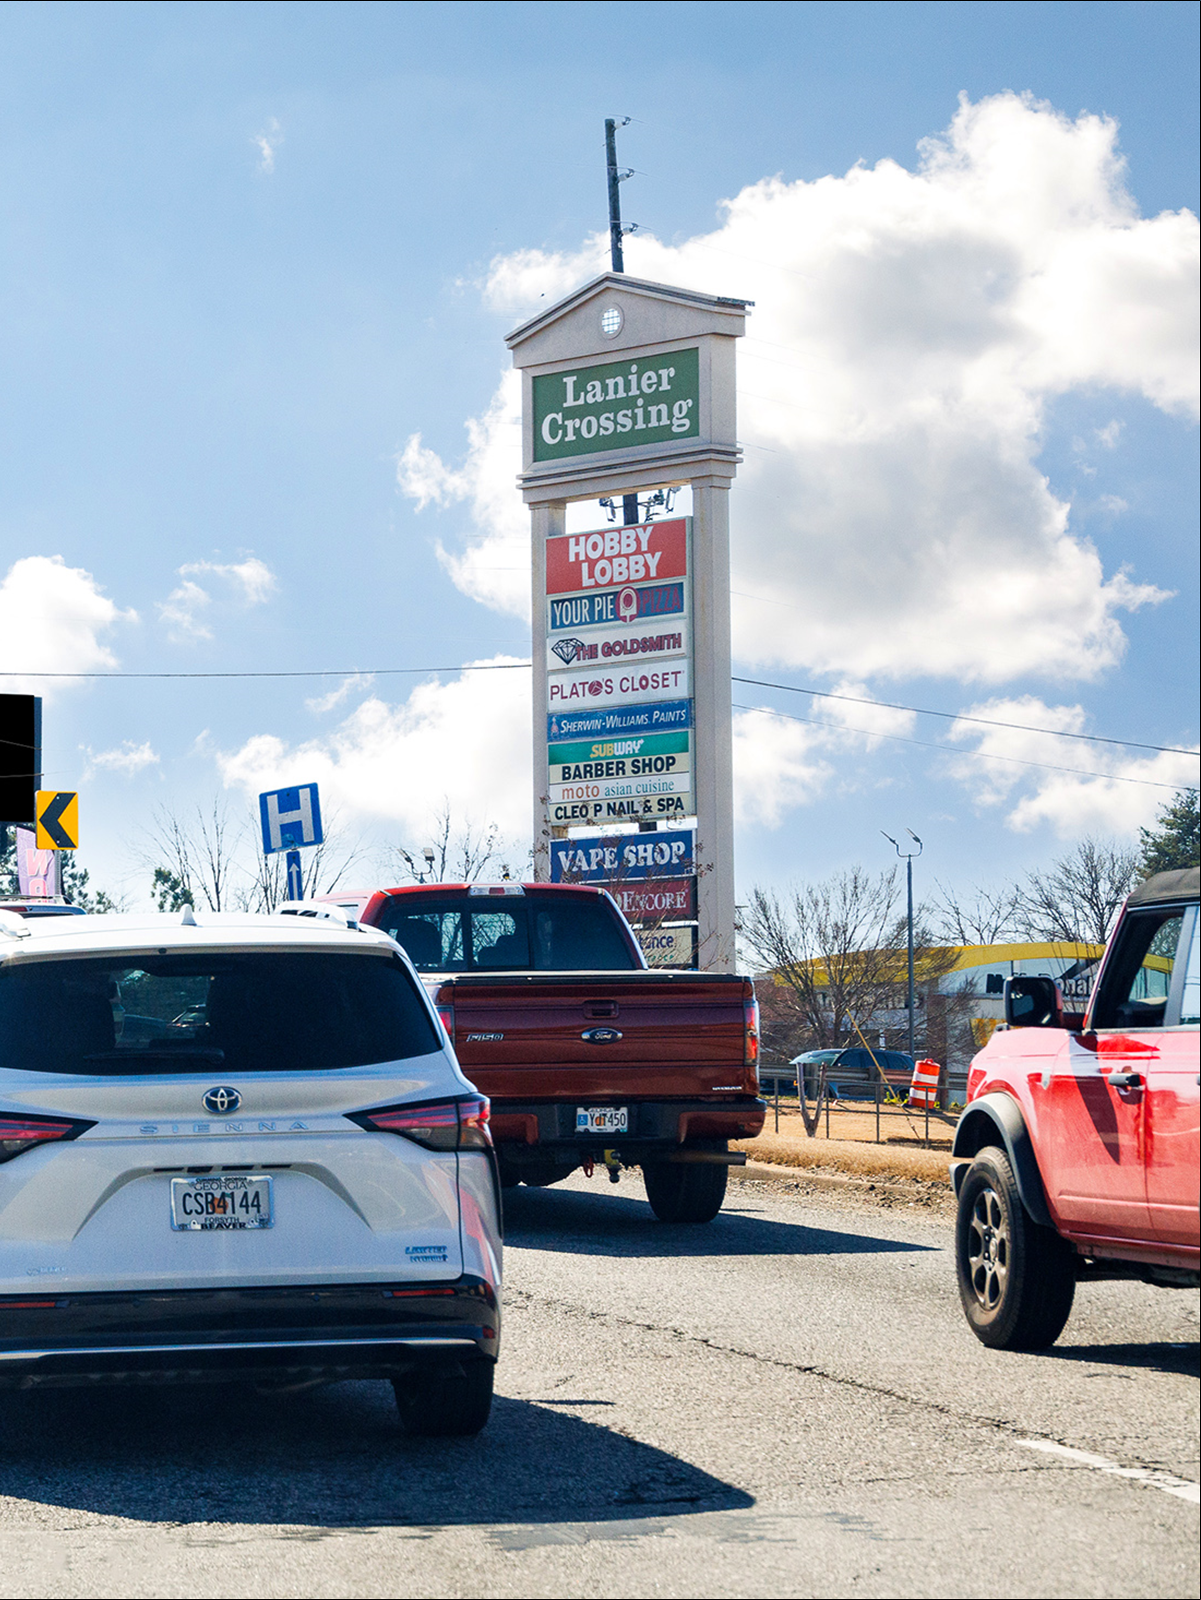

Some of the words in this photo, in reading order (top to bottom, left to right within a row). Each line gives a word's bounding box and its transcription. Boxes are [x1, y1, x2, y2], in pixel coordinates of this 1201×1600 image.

[563, 364, 675, 407] Lanier
[541, 398, 692, 444] Crossing
[569, 526, 654, 562] HOBBY
[582, 552, 662, 587] LOBBY
[553, 598, 590, 626] YOUR
[594, 595, 614, 621] PIE
[642, 587, 681, 614] PIZZA
[575, 643, 598, 661] THE
[601, 633, 682, 657] GOLDSMITH
[550, 678, 613, 700] PLATO'S
[619, 671, 681, 692] CLOSET
[652, 709, 686, 723] PAINTS
[590, 739, 644, 758] SUBWAY
[562, 760, 626, 781] BARBER
[631, 756, 676, 774] SHOP
[562, 784, 600, 799] moto
[604, 782, 632, 797] asian
[635, 779, 674, 794] cuisine
[266, 787, 315, 849] H
[555, 805, 588, 820] CLEO
[593, 803, 602, 817] P
[607, 800, 639, 816] NAIL
[643, 799, 653, 813] &
[657, 797, 684, 812] SPA
[557, 846, 618, 872] VAPE
[623, 841, 686, 867] SHOP
[595, 1031, 612, 1040] Ford
[139, 1121, 309, 1134] SIENNA
[194, 1181, 247, 1191] GEORGIA
[182, 1191, 261, 1215] CSB4144
[201, 1222, 246, 1230] BEAVER
